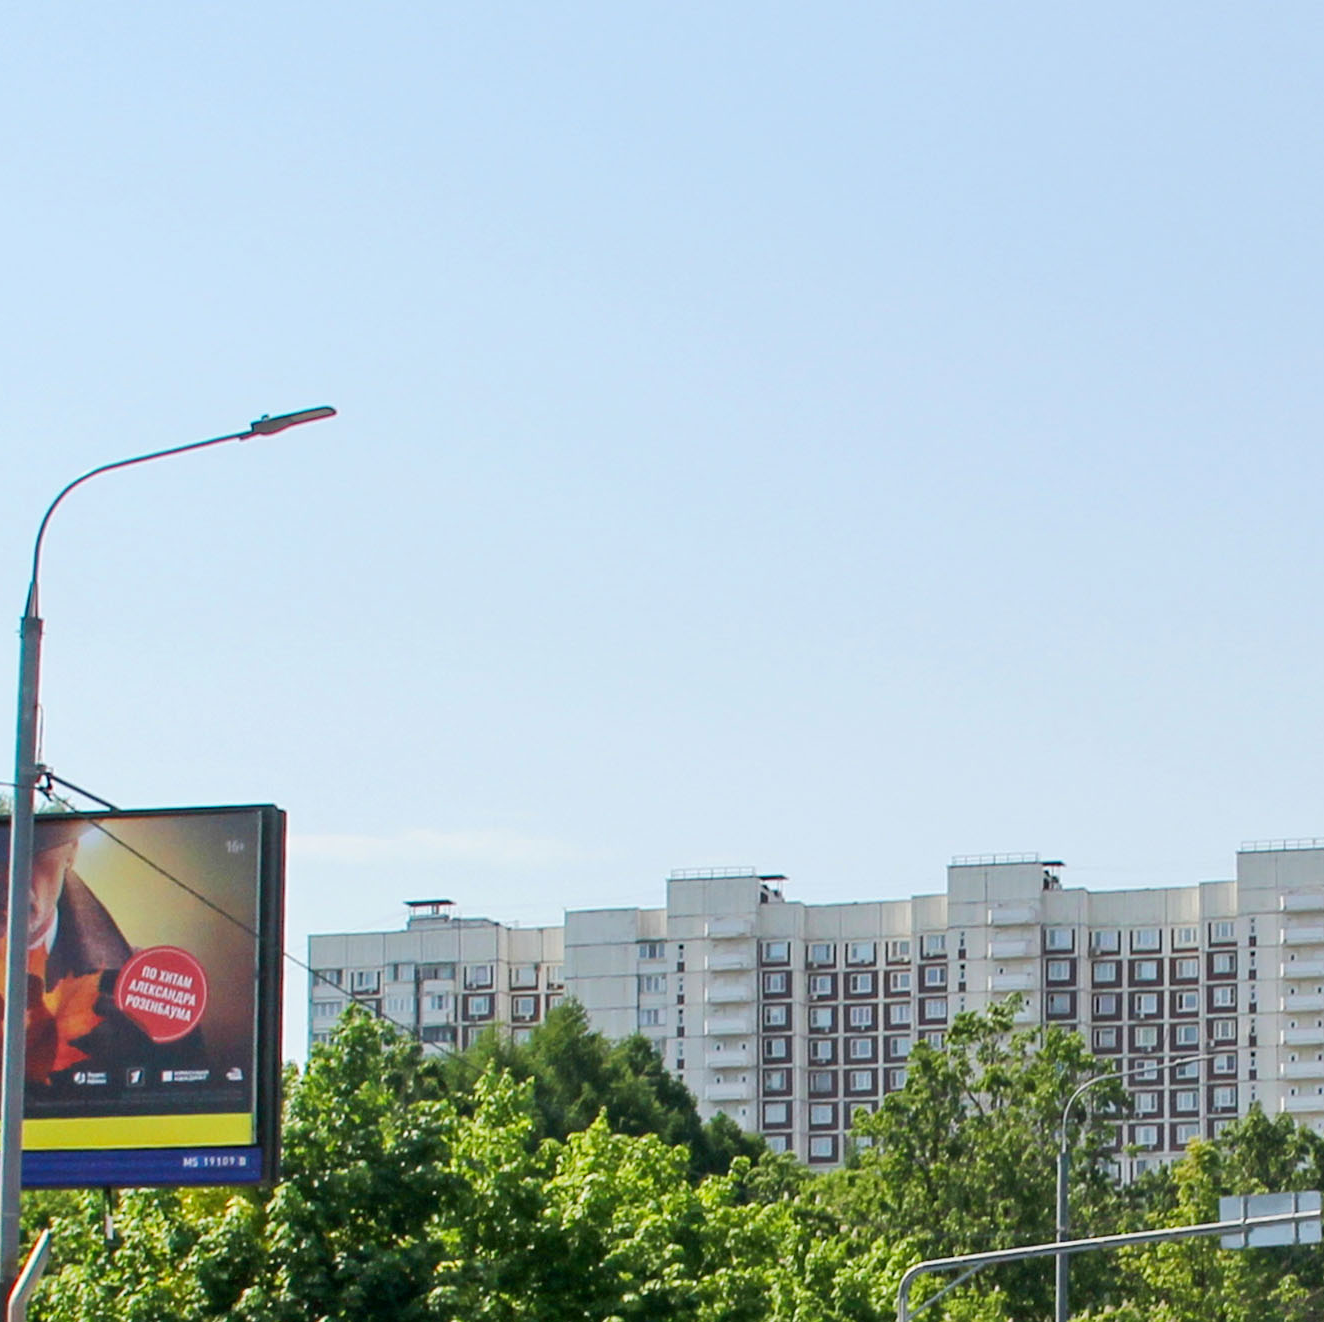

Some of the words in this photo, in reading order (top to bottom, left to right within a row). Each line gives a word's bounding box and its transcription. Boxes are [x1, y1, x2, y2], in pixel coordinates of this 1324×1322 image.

[142, 965, 158, 980] ПО
[159, 970, 193, 989] ХИТАМ
[128, 978, 196, 1007] АЛЕКСАНДРА
[125, 994, 192, 1022] РОЗЕНБАУМА
